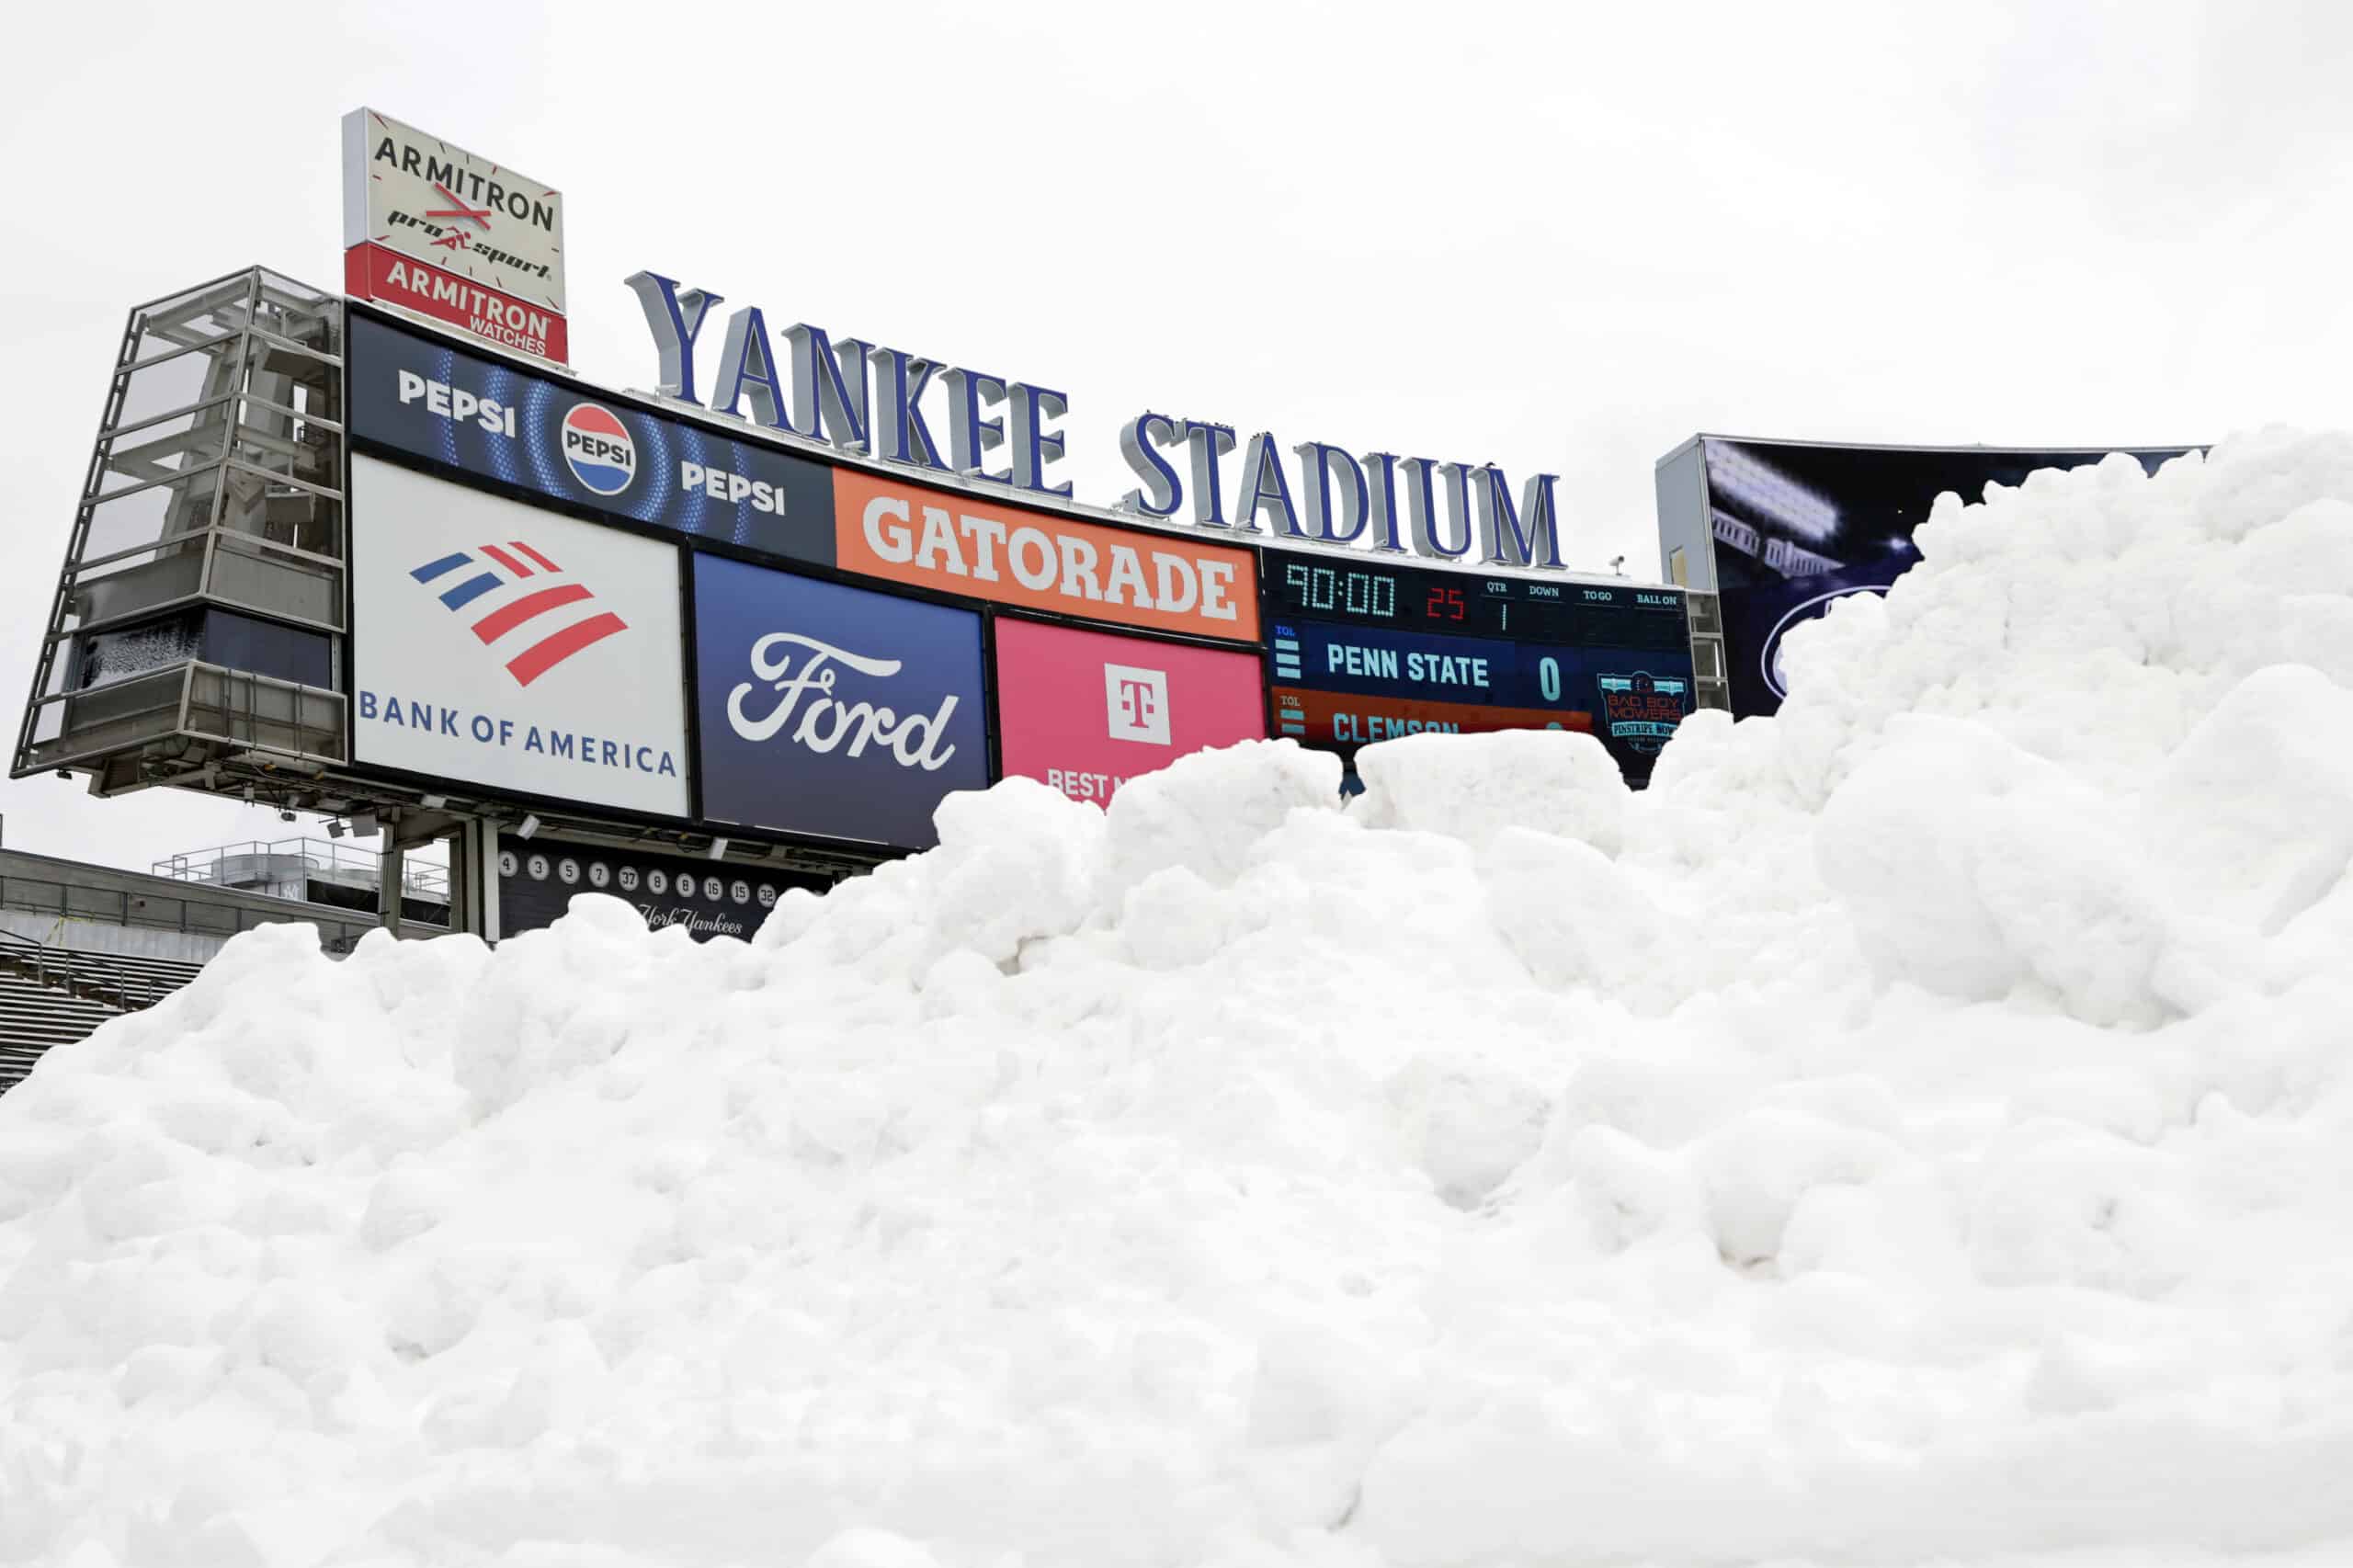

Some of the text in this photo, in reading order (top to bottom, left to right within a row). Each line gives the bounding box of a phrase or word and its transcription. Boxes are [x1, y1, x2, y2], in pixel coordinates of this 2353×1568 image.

[373, 137, 553, 233] ARMITRON
[387, 210, 550, 278] pro sport
[386, 261, 550, 340] ARMITRON
[470, 315, 546, 356] WATCHES
[398, 369, 517, 438] PEPSI
[623, 270, 1568, 570] YANKEE STADIUM
[566, 430, 632, 468] PEPSI
[680, 460, 786, 516] PEPSI
[862, 496, 1237, 621] GATORADE
[1287, 563, 1394, 618] 90:00
[1427, 587, 1464, 620] 25
[1486, 581, 1507, 594] QTR
[1529, 585, 1560, 597] DOWN
[1583, 590, 1612, 601] TO GO
[1637, 594, 1677, 605] BALL ON
[1275, 625, 1296, 637] TOL
[1327, 643, 1490, 687] PENN STATE
[1539, 656, 1561, 702] 0
[727, 631, 960, 771] Ford
[1279, 695, 1301, 707] TOL
[359, 690, 676, 778] BANK OF AMERICA
[1047, 768, 1108, 798] BEST
[621, 871, 636, 885] 37
[708, 881, 719, 895] 16
[734, 886, 746, 898] 15
[760, 889, 773, 902] 32
[639, 903, 744, 935] York Yankees
